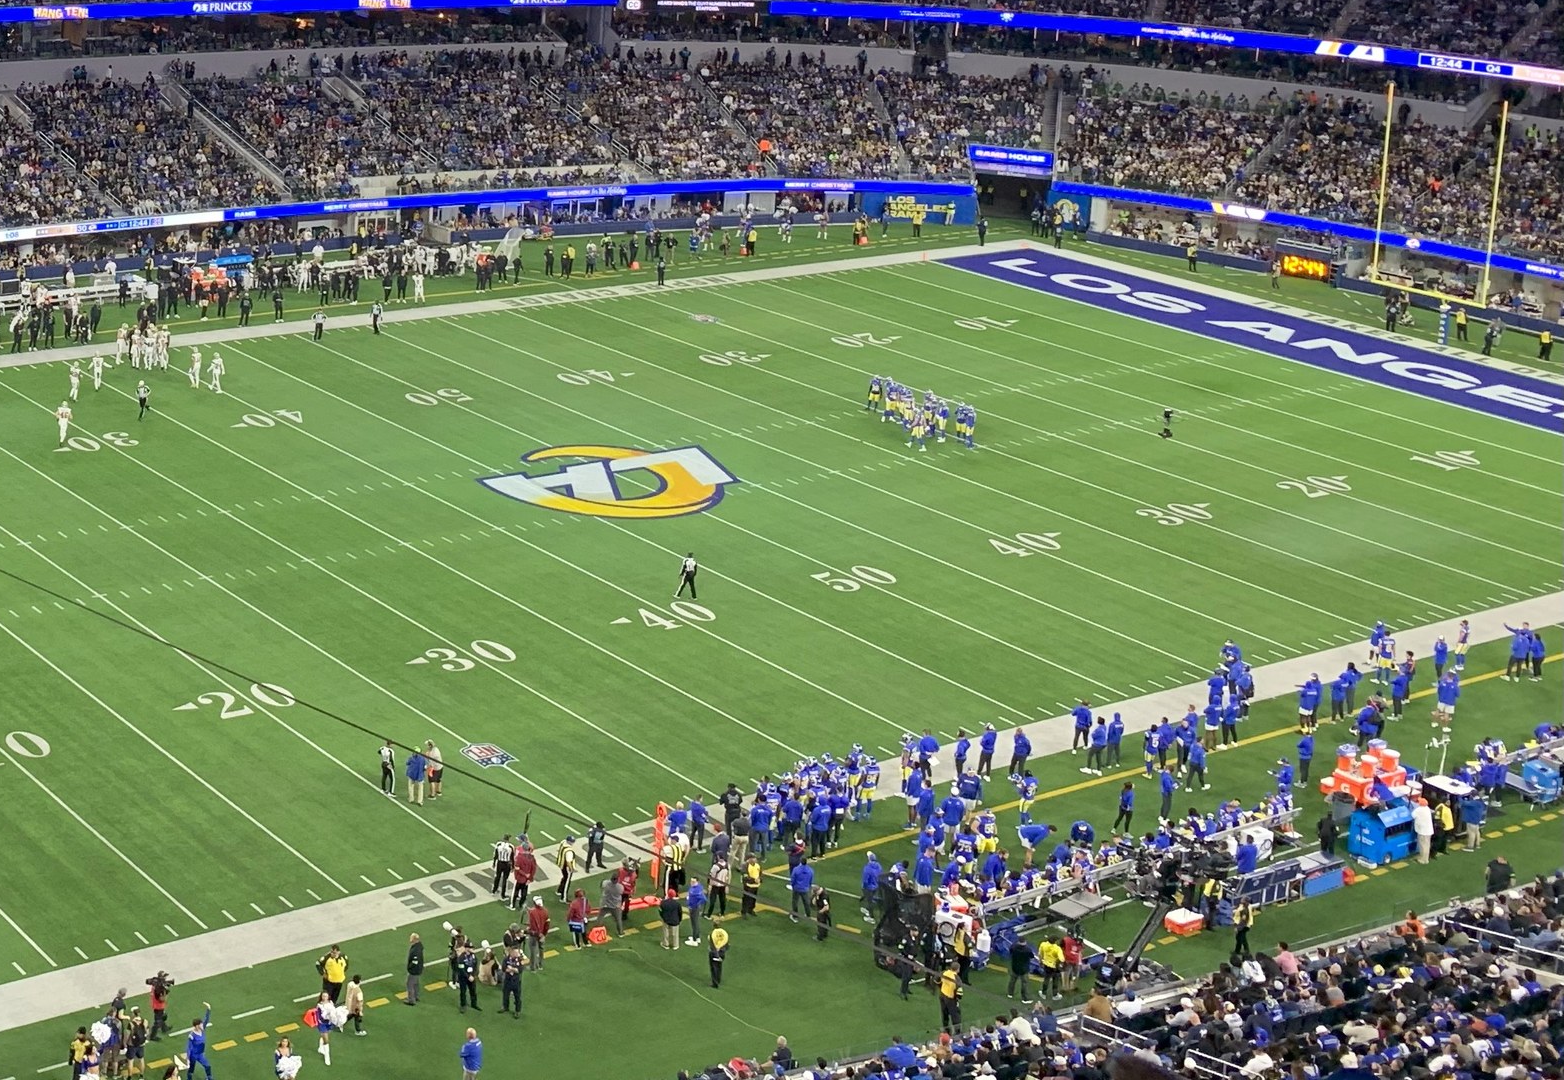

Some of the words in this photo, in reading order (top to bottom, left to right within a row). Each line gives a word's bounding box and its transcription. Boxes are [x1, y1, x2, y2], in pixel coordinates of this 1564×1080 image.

[33, 6, 64, 19] HANG
[209, 2, 252, 12] PRINCESS
[1429, 56, 1463, 69] 12:44
[1486, 63, 1501, 73] Q4
[975, 149, 1008, 160] RAMS
[1008, 152, 1046, 163] HOUSE
[784, 181, 810, 189] MERRY
[810, 181, 855, 190] CHRISTMAS
[887, 195, 916, 204] LOS
[234, 210, 256, 218] RAMS
[1282, 254, 1325, 278] 12:44
[1525, 264, 1558, 278] MERRY
[953, 314, 1012, 333] 10
[830, 331, 893, 348] 20
[989, 257, 1208, 316] LOS
[1204, 318, 1564, 422] ANGE
[698, 349, 762, 367] 30
[556, 368, 617, 387] 40
[404, 387, 474, 408] 50
[240, 407, 304, 430] 40
[67, 431, 140, 456] 30
[1409, 449, 1481, 472] 10
[1275, 475, 1352, 499] 20
[1136, 502, 1213, 527] 30
[989, 529, 1048, 560] 40
[811, 562, 898, 595] 50
[636, 598, 718, 632] 40
[424, 638, 517, 673] 30
[195, 682, 296, 721] 20
